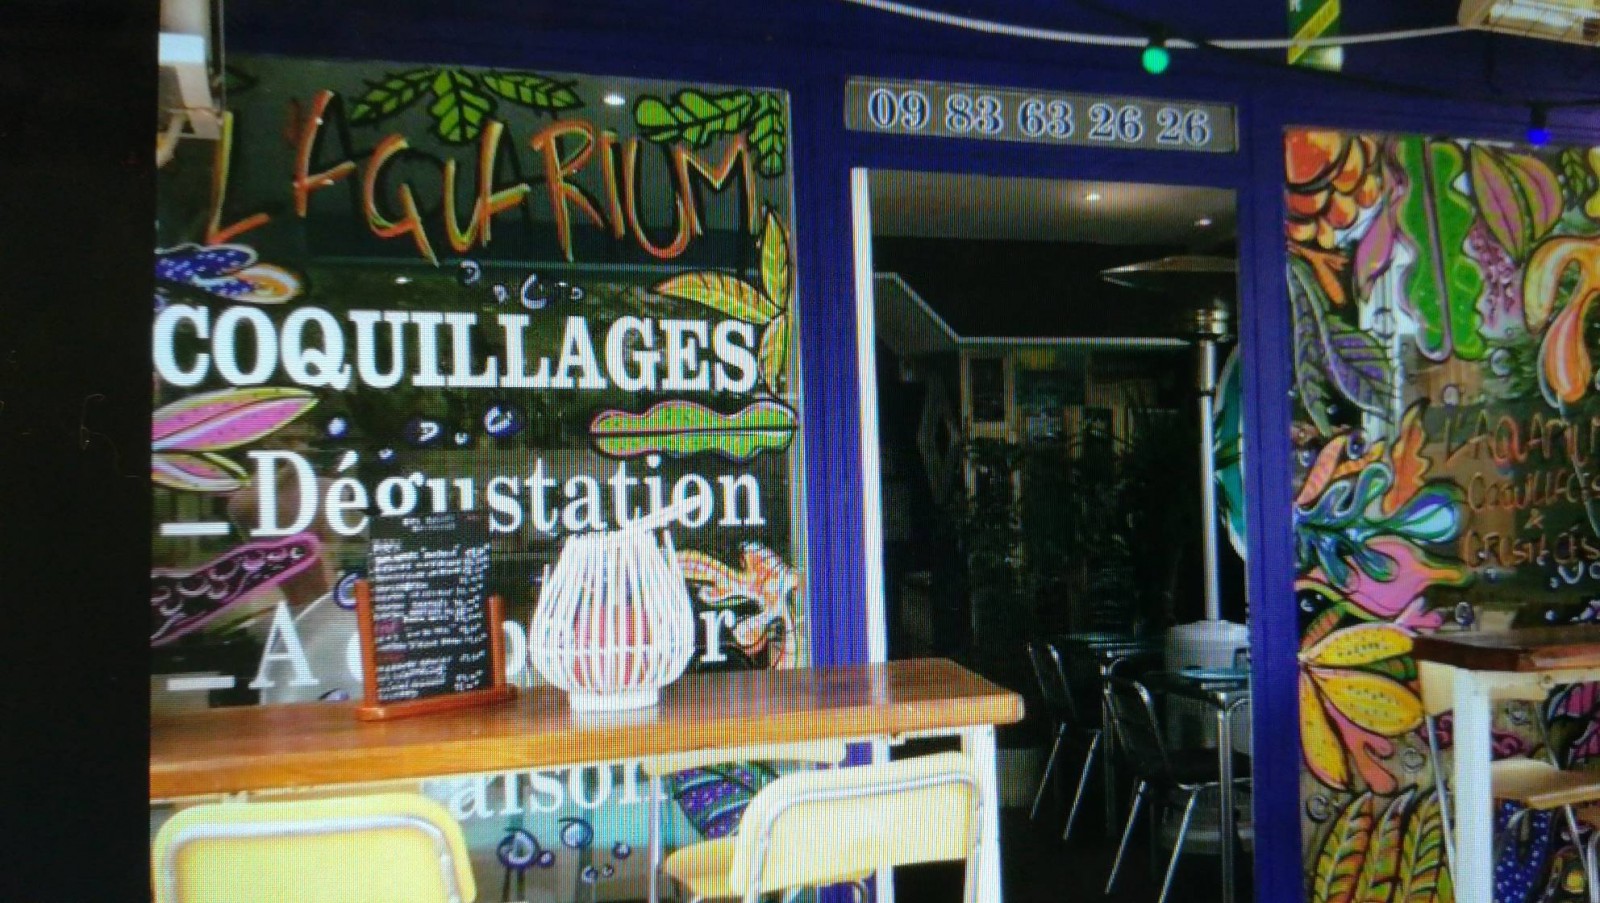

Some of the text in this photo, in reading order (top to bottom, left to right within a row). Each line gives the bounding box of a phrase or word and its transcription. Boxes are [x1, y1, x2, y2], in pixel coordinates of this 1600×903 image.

[867, 87, 1212, 147] 09 83 63 26 26
[152, 305, 758, 392] COQUILLAGES
[249, 450, 766, 538] Dégustation
